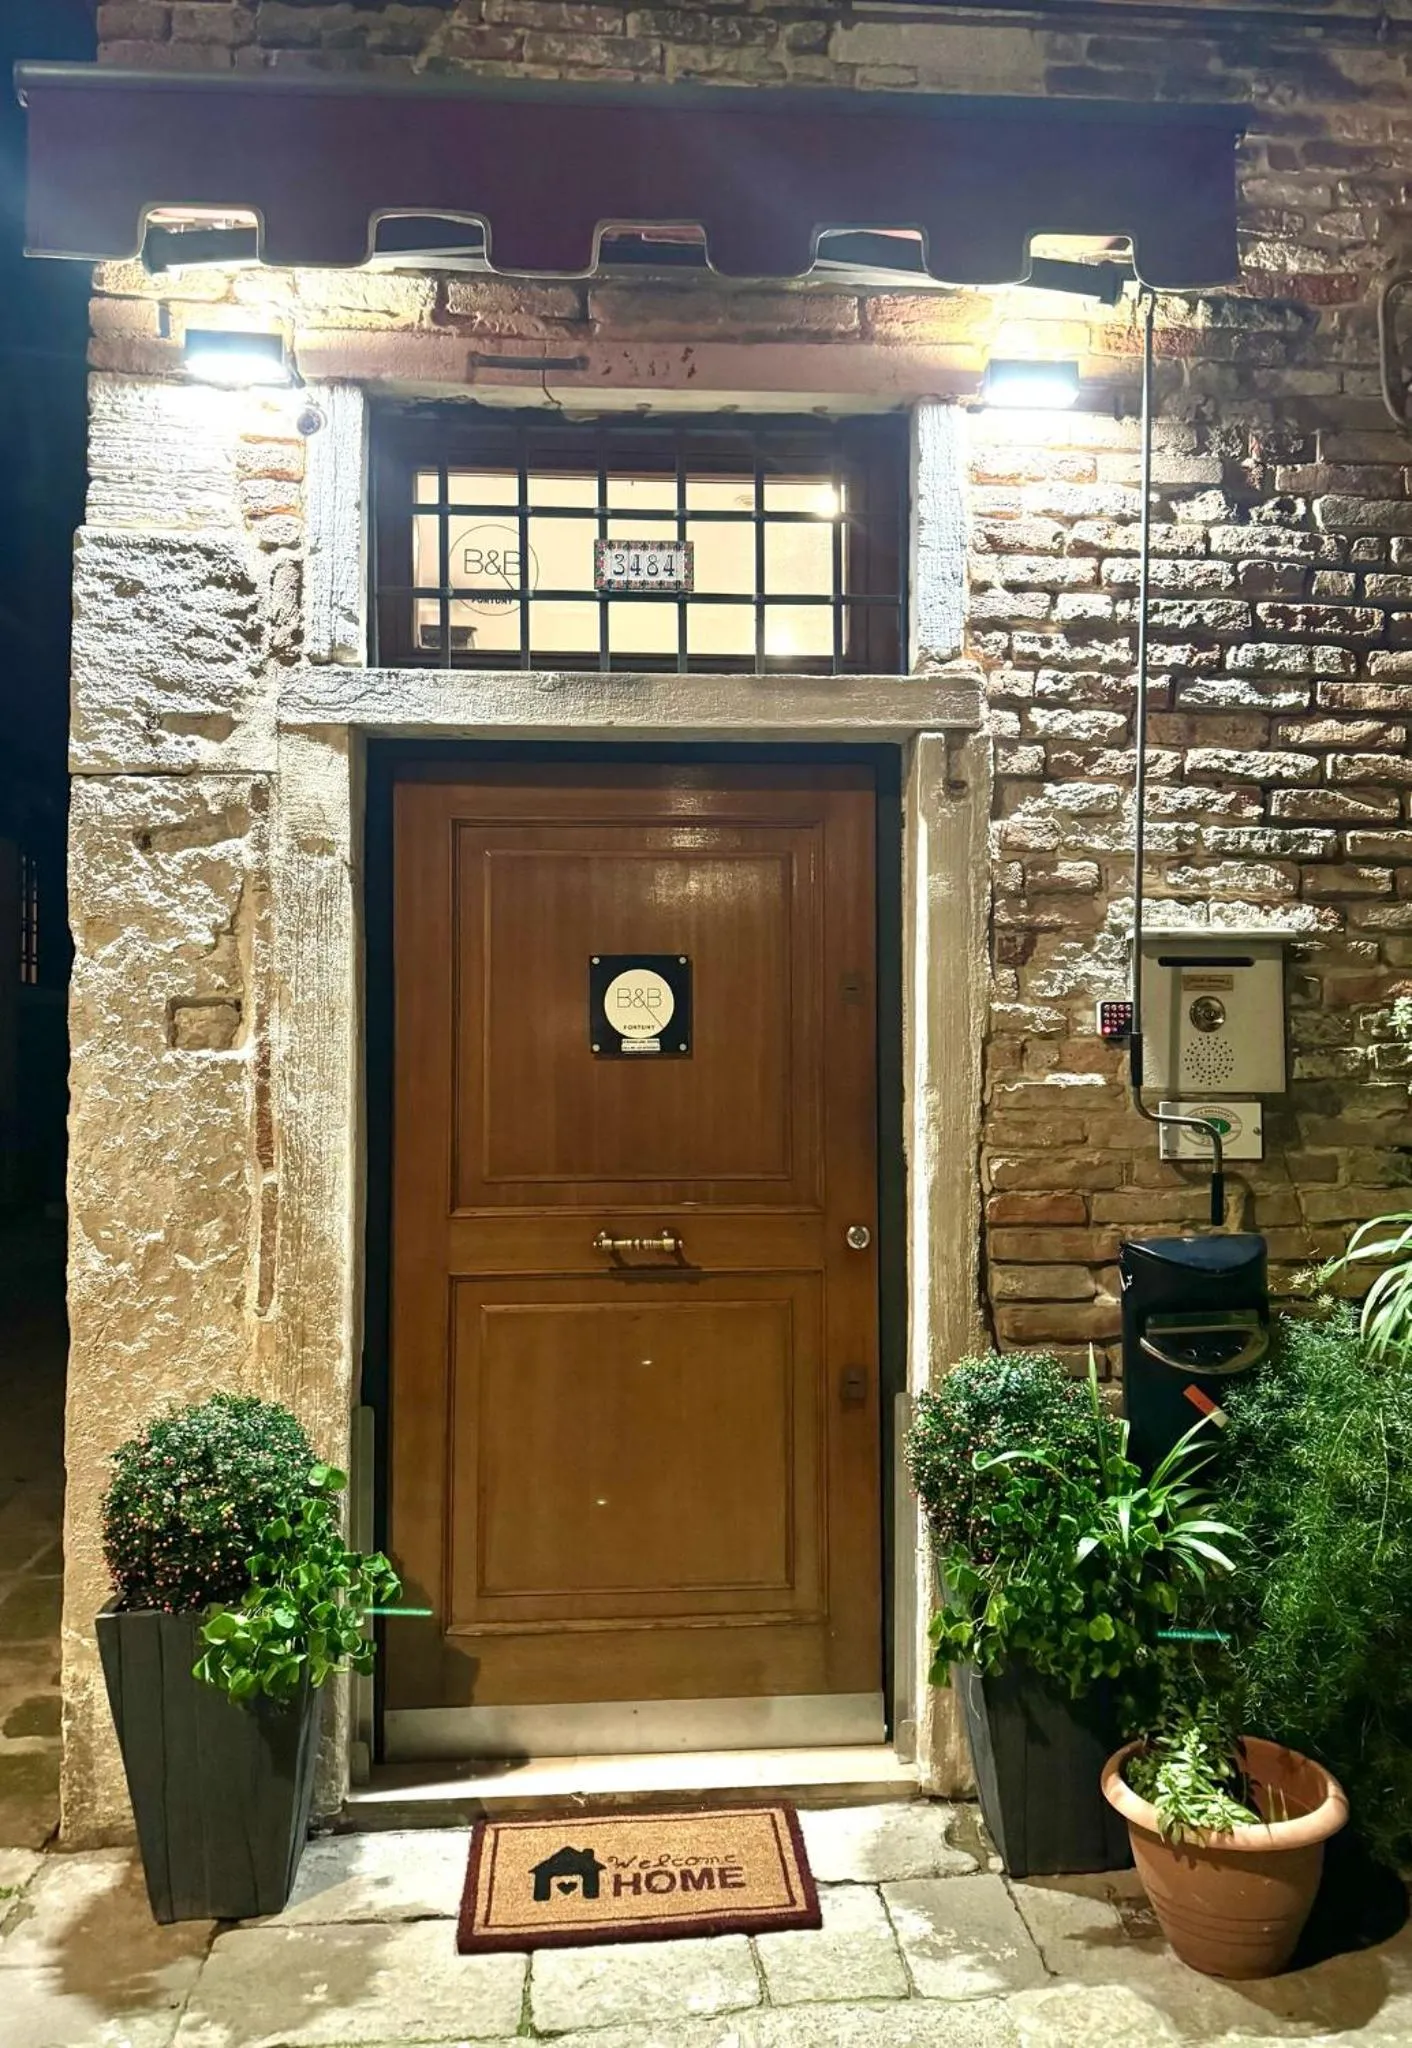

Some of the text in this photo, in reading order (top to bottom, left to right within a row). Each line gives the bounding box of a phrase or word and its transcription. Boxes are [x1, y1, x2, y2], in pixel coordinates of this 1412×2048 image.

[464, 548, 523, 576] B&B
[612, 553, 676, 577] 3484
[617, 988, 662, 1008] B&B
[607, 1853, 737, 1869] Welcome
[612, 1866, 746, 1897] HOME
